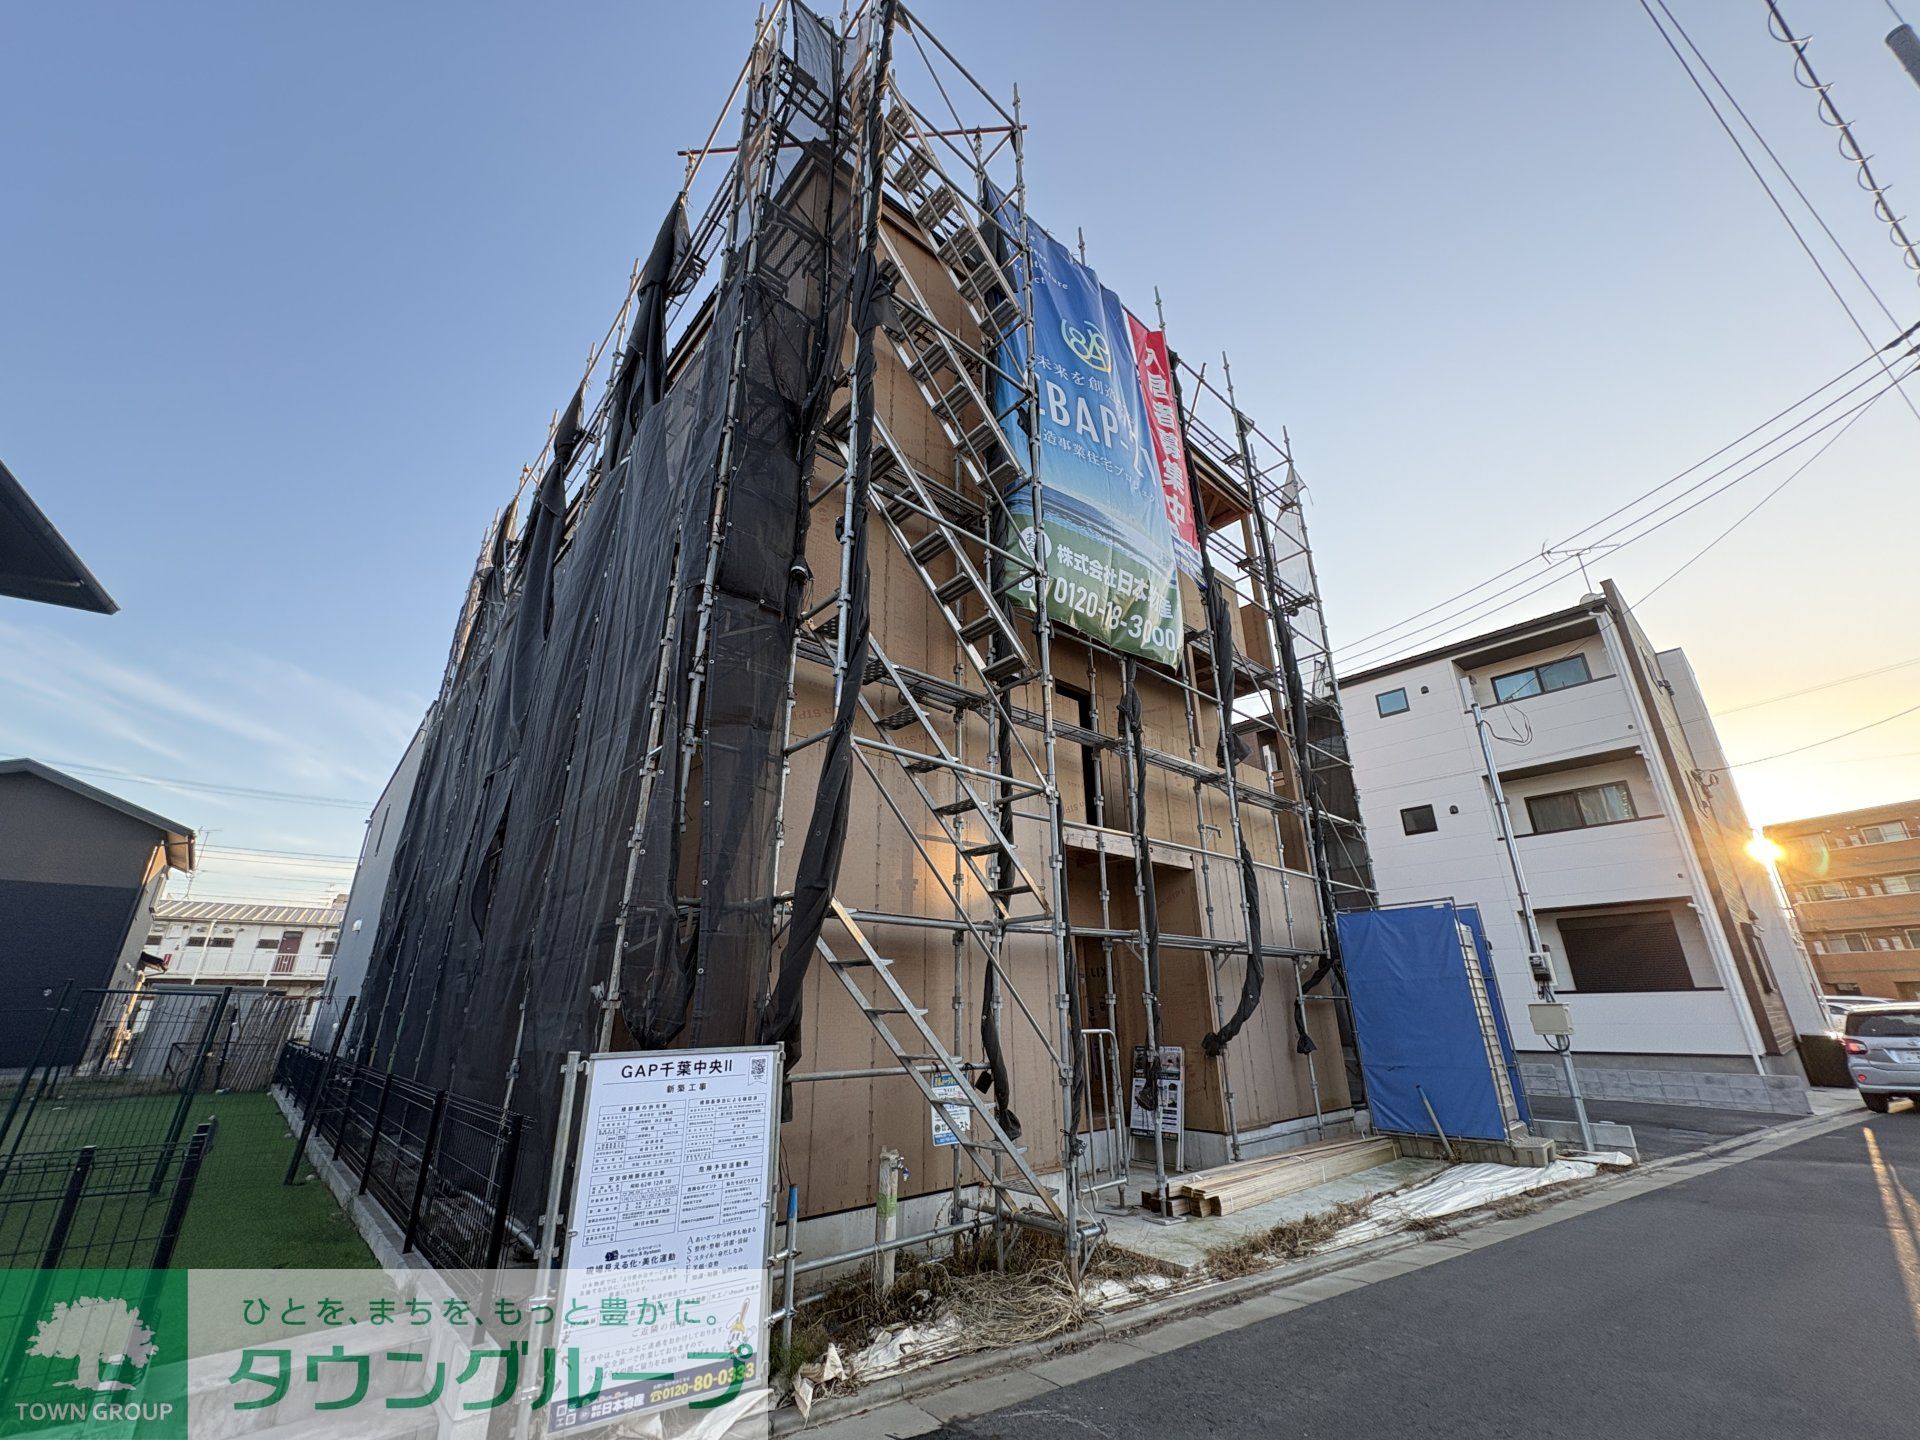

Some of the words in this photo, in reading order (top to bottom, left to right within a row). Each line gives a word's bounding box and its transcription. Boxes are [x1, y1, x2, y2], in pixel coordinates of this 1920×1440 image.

[1056, 543, 1173, 619] 株式会社日本物産
[666, 1083, 708, 1094] 新築工事
[602, 1393, 645, 1416] 日本物産
